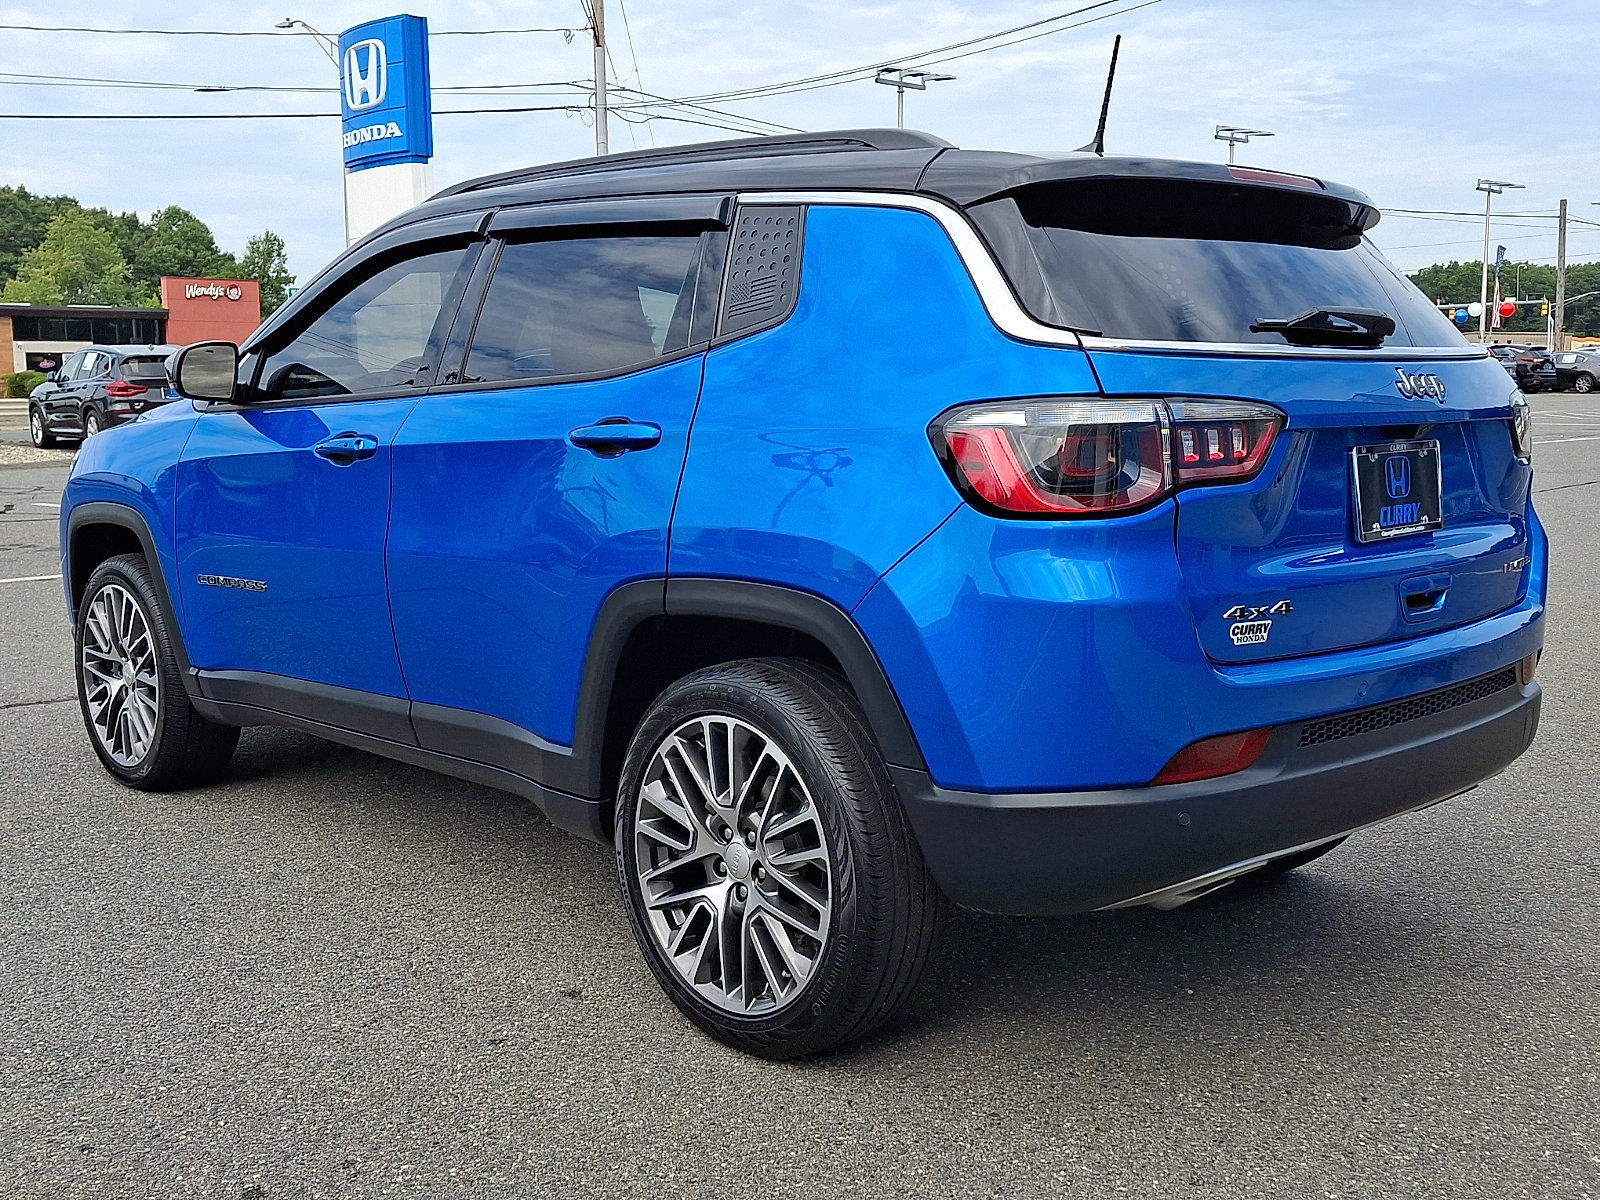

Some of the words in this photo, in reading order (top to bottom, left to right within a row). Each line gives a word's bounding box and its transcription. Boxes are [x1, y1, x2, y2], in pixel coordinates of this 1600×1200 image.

[343, 122, 403, 149] HONDA
[185, 283, 225, 300] Wendy's
[1395, 367, 1446, 404] Jeep
[1380, 502, 1420, 527] CURRY
[197, 574, 267, 592] COMPASS
[1223, 600, 1294, 620] 4x4
[1231, 622, 1270, 637] CURRY
[1236, 634, 1265, 643] HONDA
